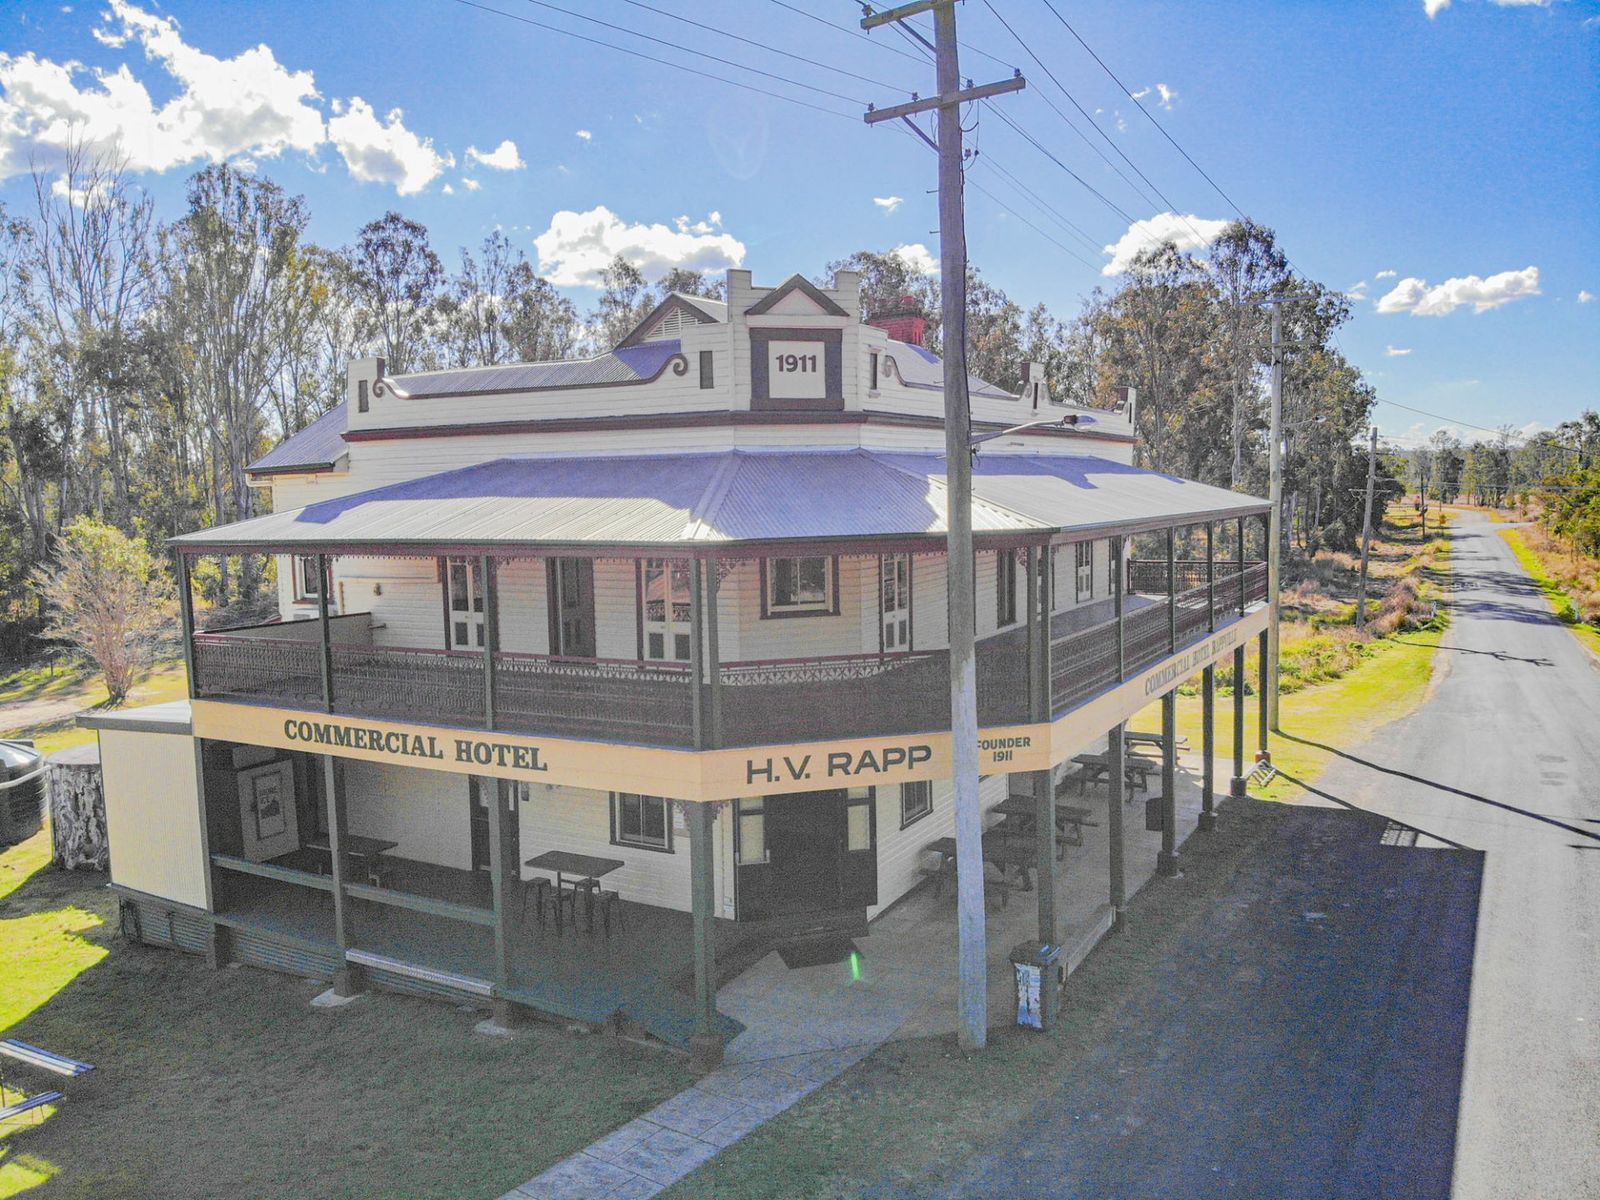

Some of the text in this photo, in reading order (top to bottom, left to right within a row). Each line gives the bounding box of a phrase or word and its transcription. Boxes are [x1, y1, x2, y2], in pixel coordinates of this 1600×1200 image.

[775, 354, 817, 373] 1911
[1145, 654, 1191, 696] COMMERCIAL
[284, 719, 548, 771] COMMERCIAL HOTEL
[746, 744, 932, 785] H.V. RAPP
[993, 750, 1013, 762] 1911
